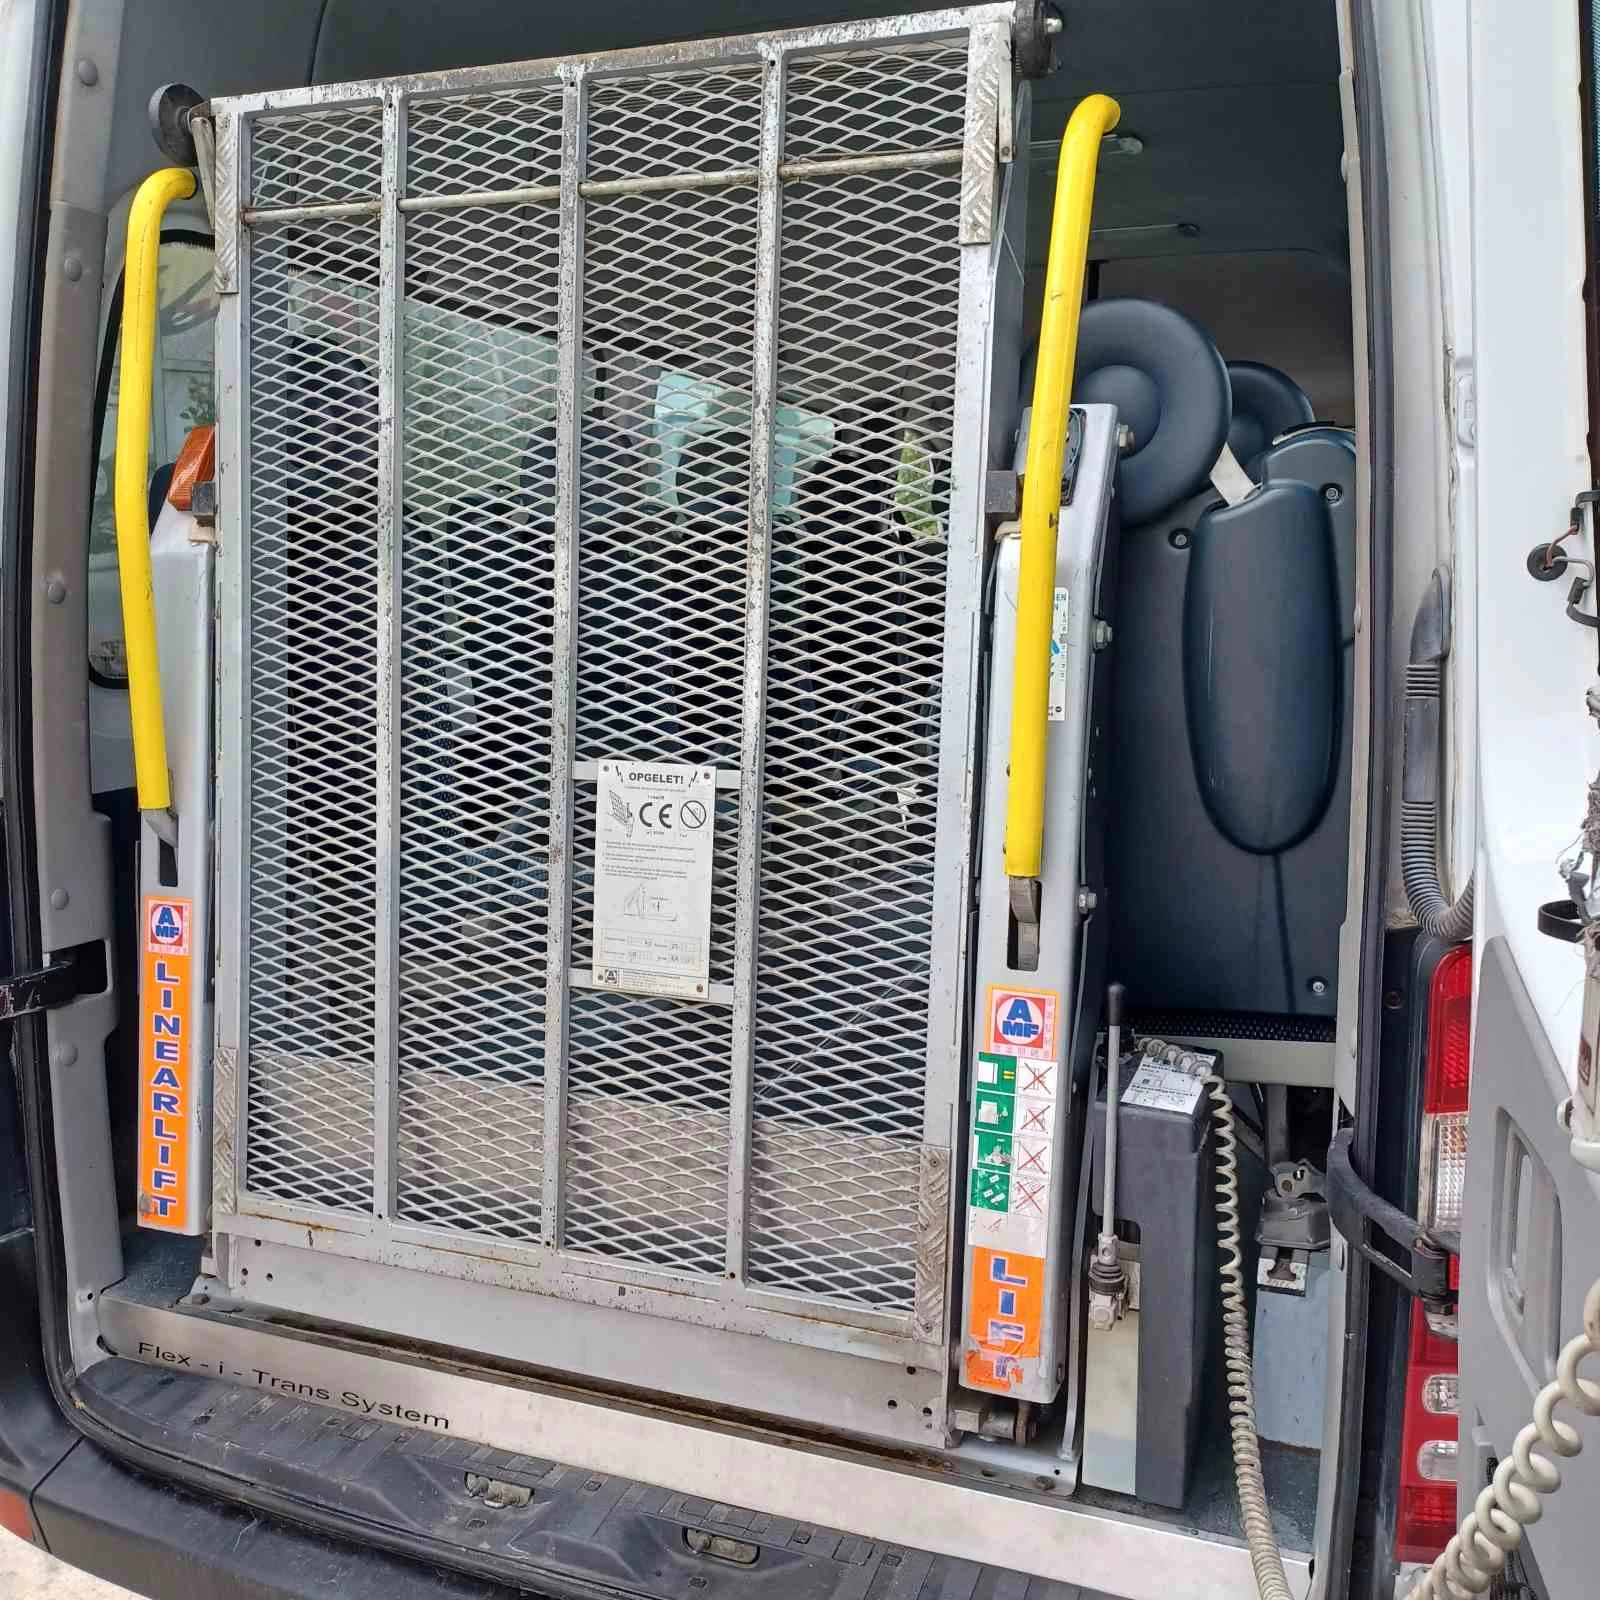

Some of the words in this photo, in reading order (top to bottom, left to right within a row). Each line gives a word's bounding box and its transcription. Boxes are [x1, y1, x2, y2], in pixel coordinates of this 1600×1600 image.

[628, 772, 684, 785] OPGELET!
[640, 801, 673, 829] CE
[158, 906, 175, 926] A
[155, 925, 180, 938] MF
[1006, 998, 1033, 1022] A
[1002, 1020, 1040, 1038] MF
[152, 962, 181, 1217] LINEARLIFT
[138, 1342, 190, 1367] Flex
[252, 1369, 330, 1400] Trans
[341, 1391, 450, 1430] System
